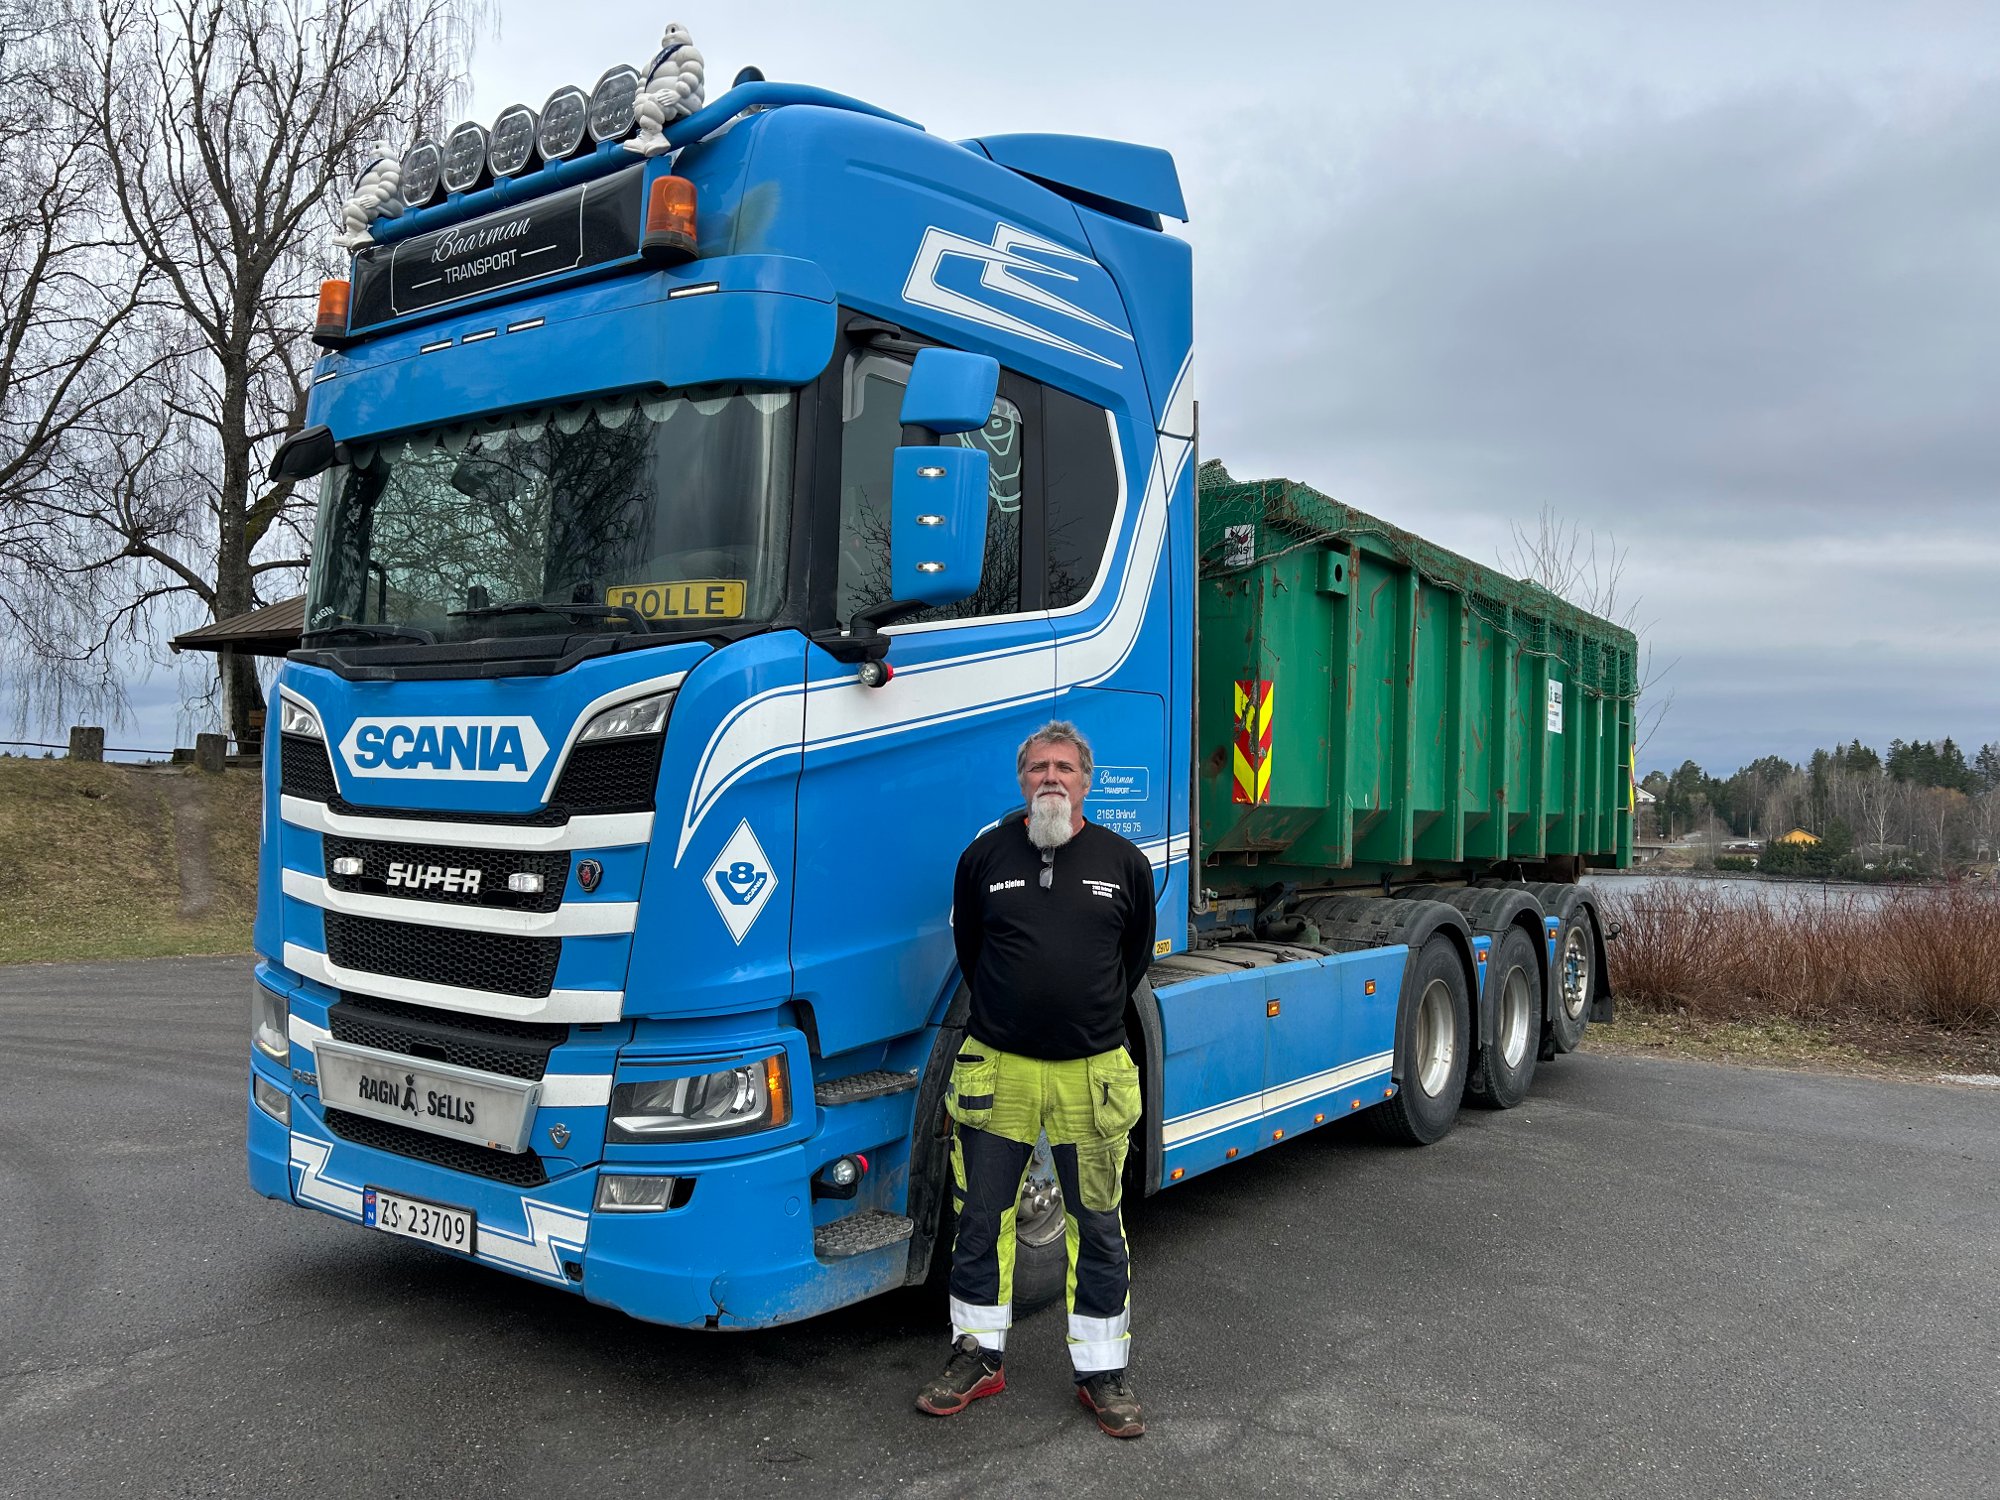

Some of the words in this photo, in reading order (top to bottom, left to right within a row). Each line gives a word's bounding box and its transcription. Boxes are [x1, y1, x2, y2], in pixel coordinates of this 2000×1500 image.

[431, 217, 531, 263] Baarman
[444, 248, 517, 284] TRANSPORT
[354, 725, 528, 772] SCANIA
[1100, 770, 1134, 784] Baarman
[1096, 809, 1115, 820] 2162
[1112, 823, 1121, 832] 37
[1122, 822, 1132, 833] 59
[1133, 822, 1142, 832] 75
[387, 863, 482, 894] SUPER
[743, 877, 765, 903] SCANIA
[1156, 941, 1170, 954] 2970
[359, 1075, 399, 1107] RAGN
[427, 1090, 475, 1125] SELLS
[367, 1211, 374, 1220] N
[381, 1198, 399, 1228] ZS
[408, 1205, 465, 1244] 23709
